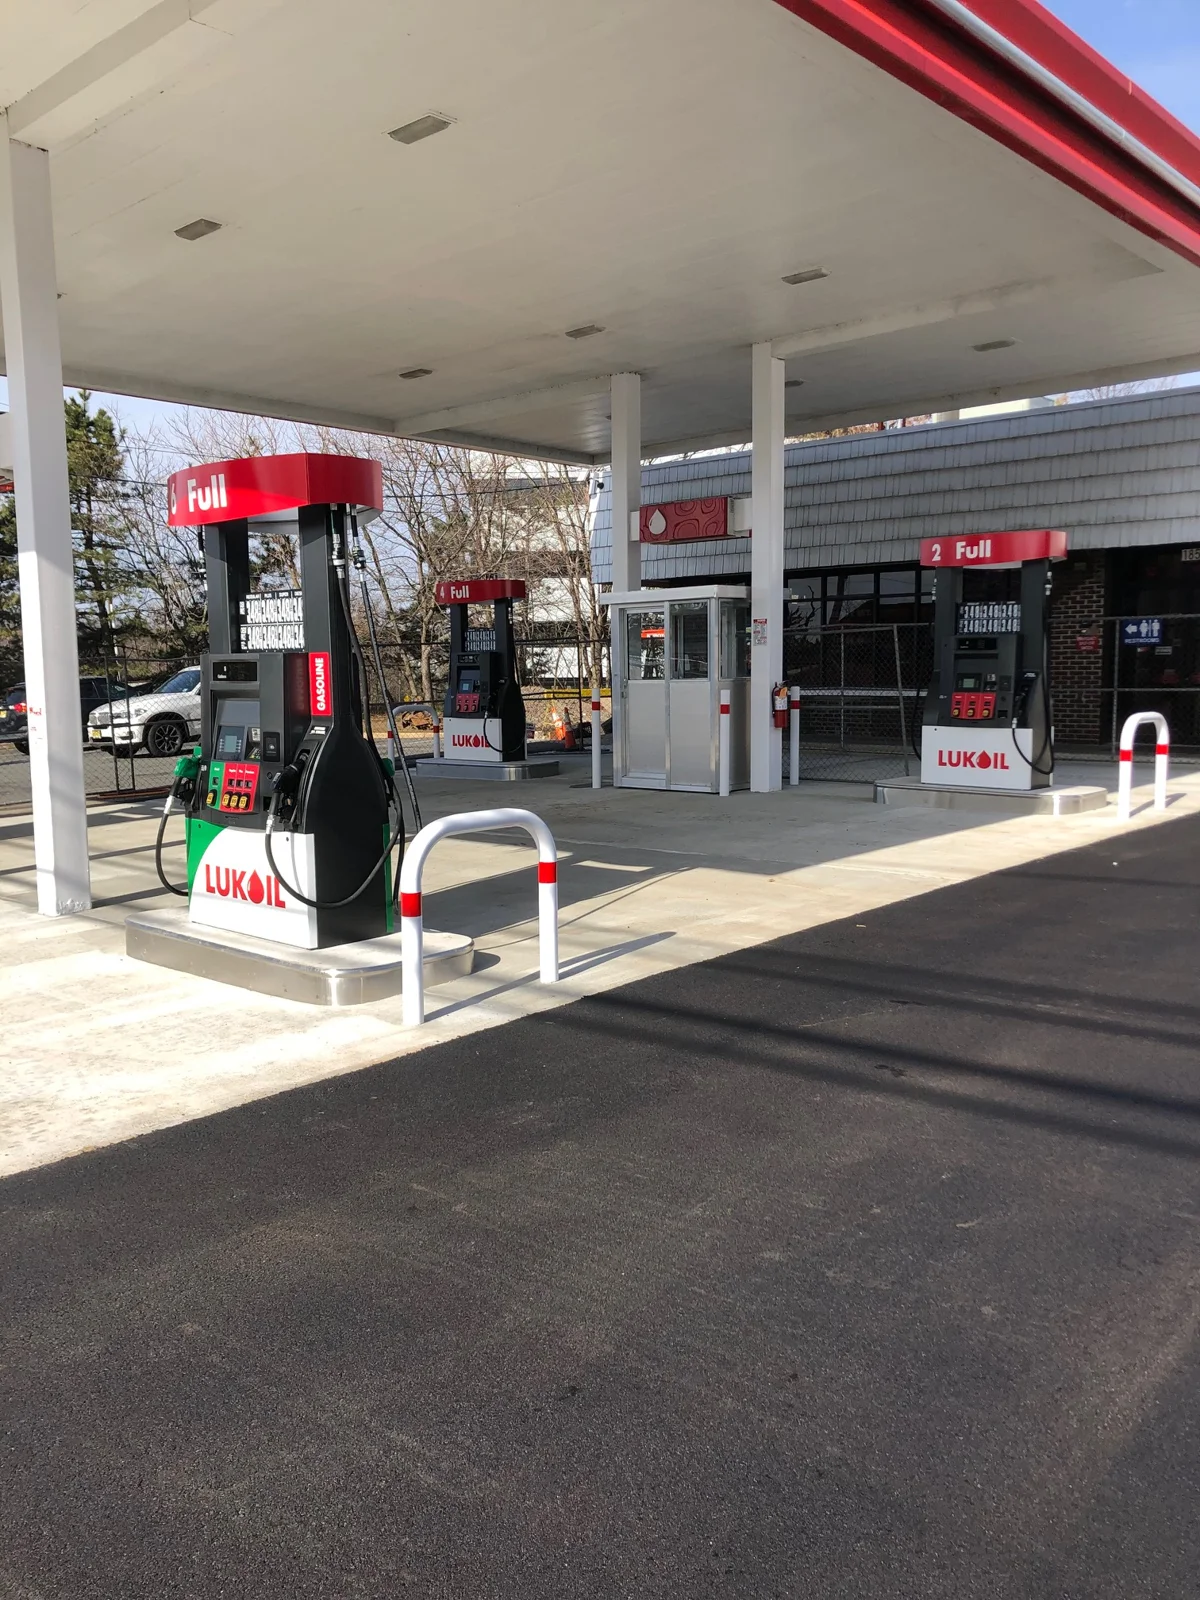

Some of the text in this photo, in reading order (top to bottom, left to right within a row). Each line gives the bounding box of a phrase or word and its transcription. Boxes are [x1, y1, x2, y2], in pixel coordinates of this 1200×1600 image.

[171, 473, 228, 515] 6 Full
[931, 539, 991, 562] 2 Full
[440, 585, 469, 599] 4 Full
[314, 657, 326, 711] GASOLINE
[452, 734, 490, 748] LUKOIL
[938, 749, 1010, 770] LUKOIL
[205, 864, 286, 909] LUKOIL
